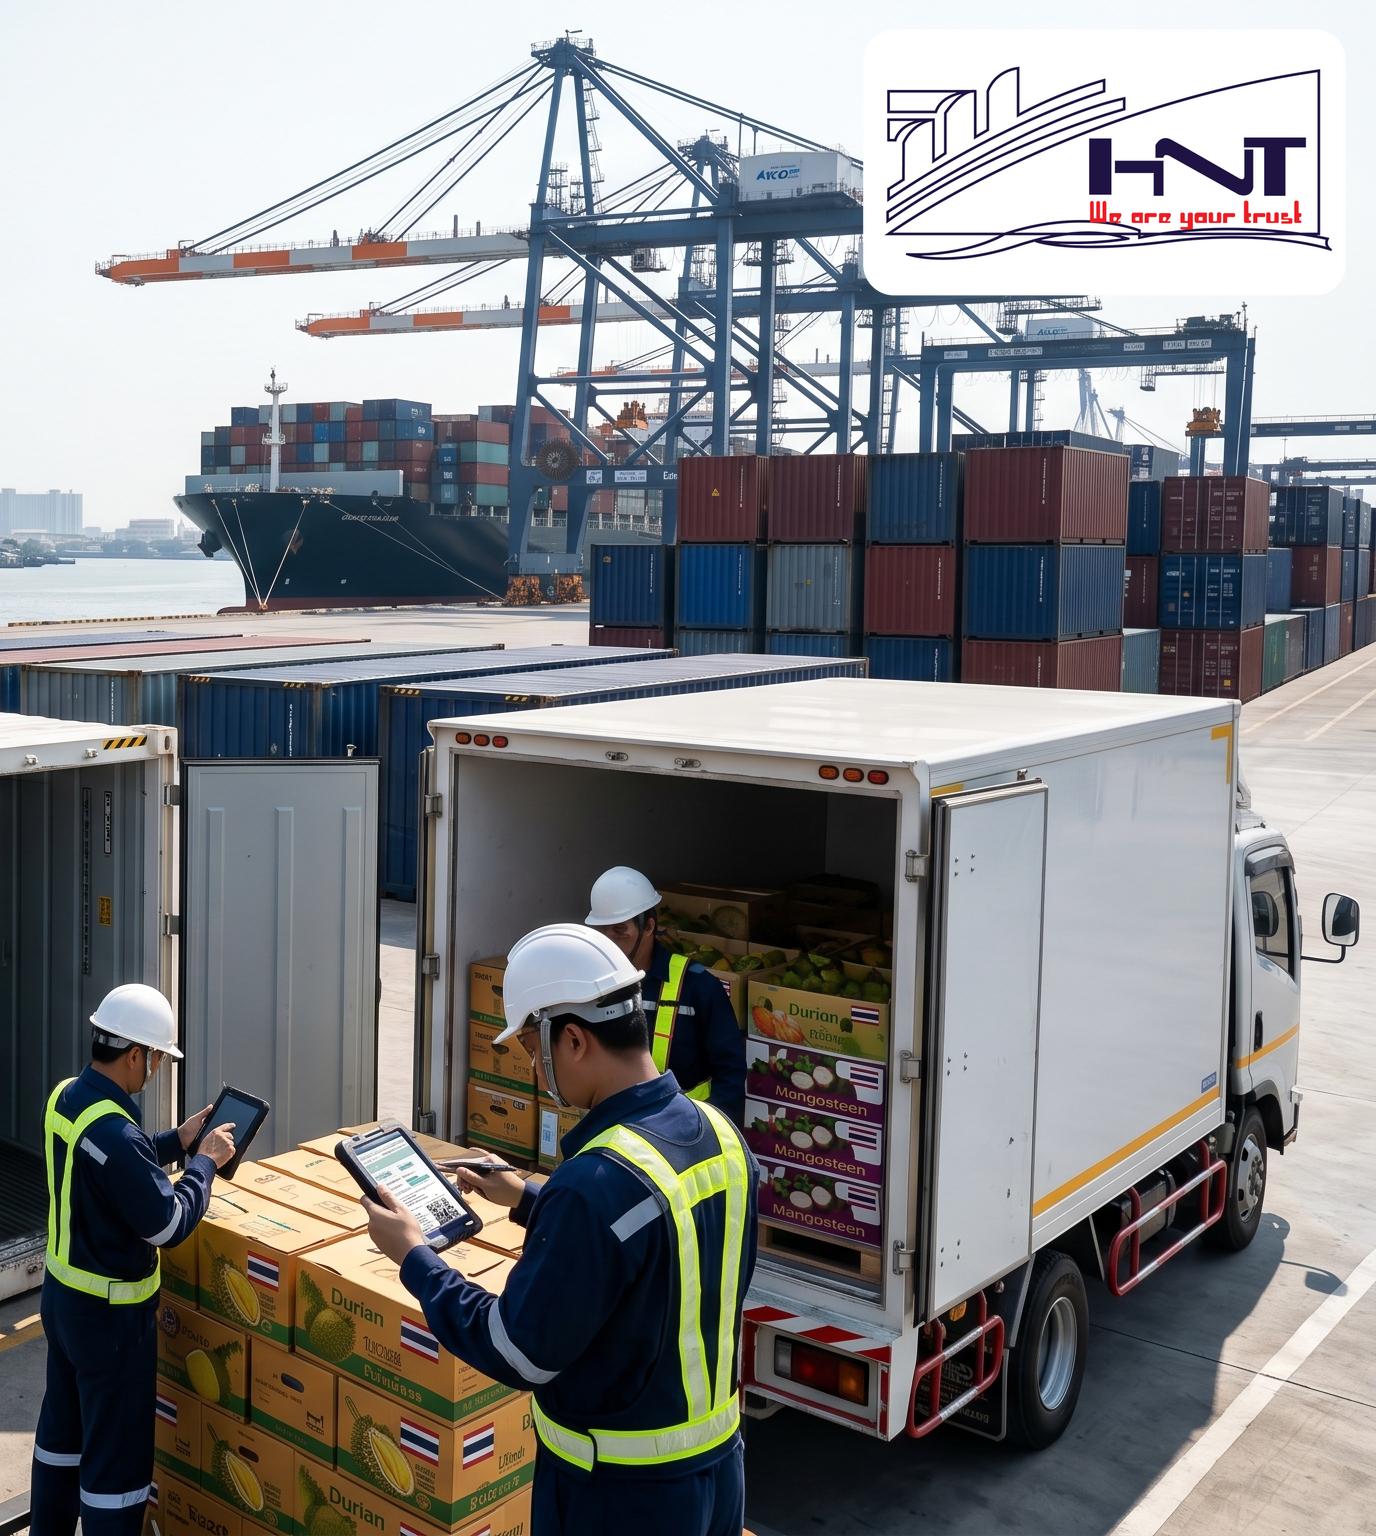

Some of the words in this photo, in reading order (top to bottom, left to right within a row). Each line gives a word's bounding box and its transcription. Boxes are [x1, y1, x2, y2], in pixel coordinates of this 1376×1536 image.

[789, 1003, 839, 1025] Durian
[775, 1085, 868, 1116] Mangosteen
[774, 1144, 866, 1176] Mangosteen
[773, 1204, 865, 1237] Mangosteen
[331, 1287, 385, 1328] Durian
[329, 1486, 385, 1531] Durian
